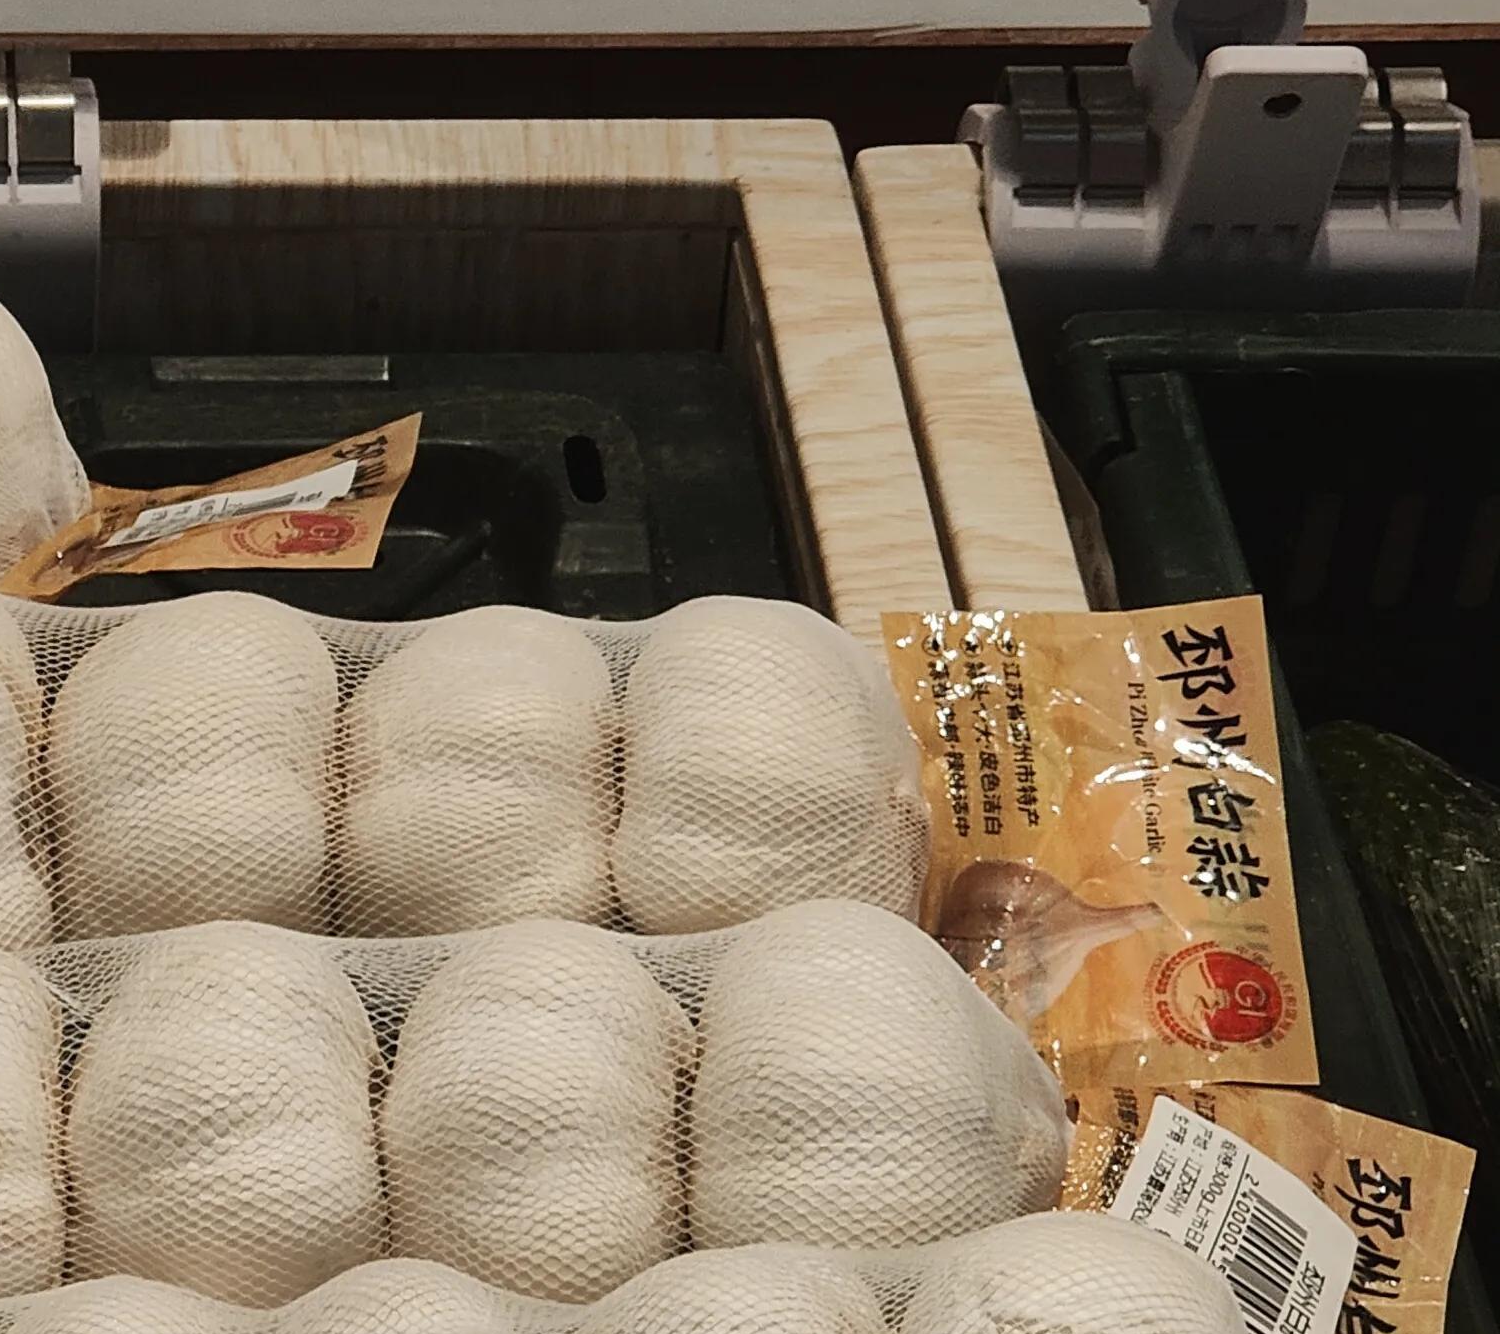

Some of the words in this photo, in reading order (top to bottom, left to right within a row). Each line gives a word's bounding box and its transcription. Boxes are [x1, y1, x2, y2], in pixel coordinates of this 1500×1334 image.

[1126, 681, 1145, 701] Pi
[1143, 804, 1168, 855] Garlic
[1156, 623, 1270, 901] 邳州白蒜
